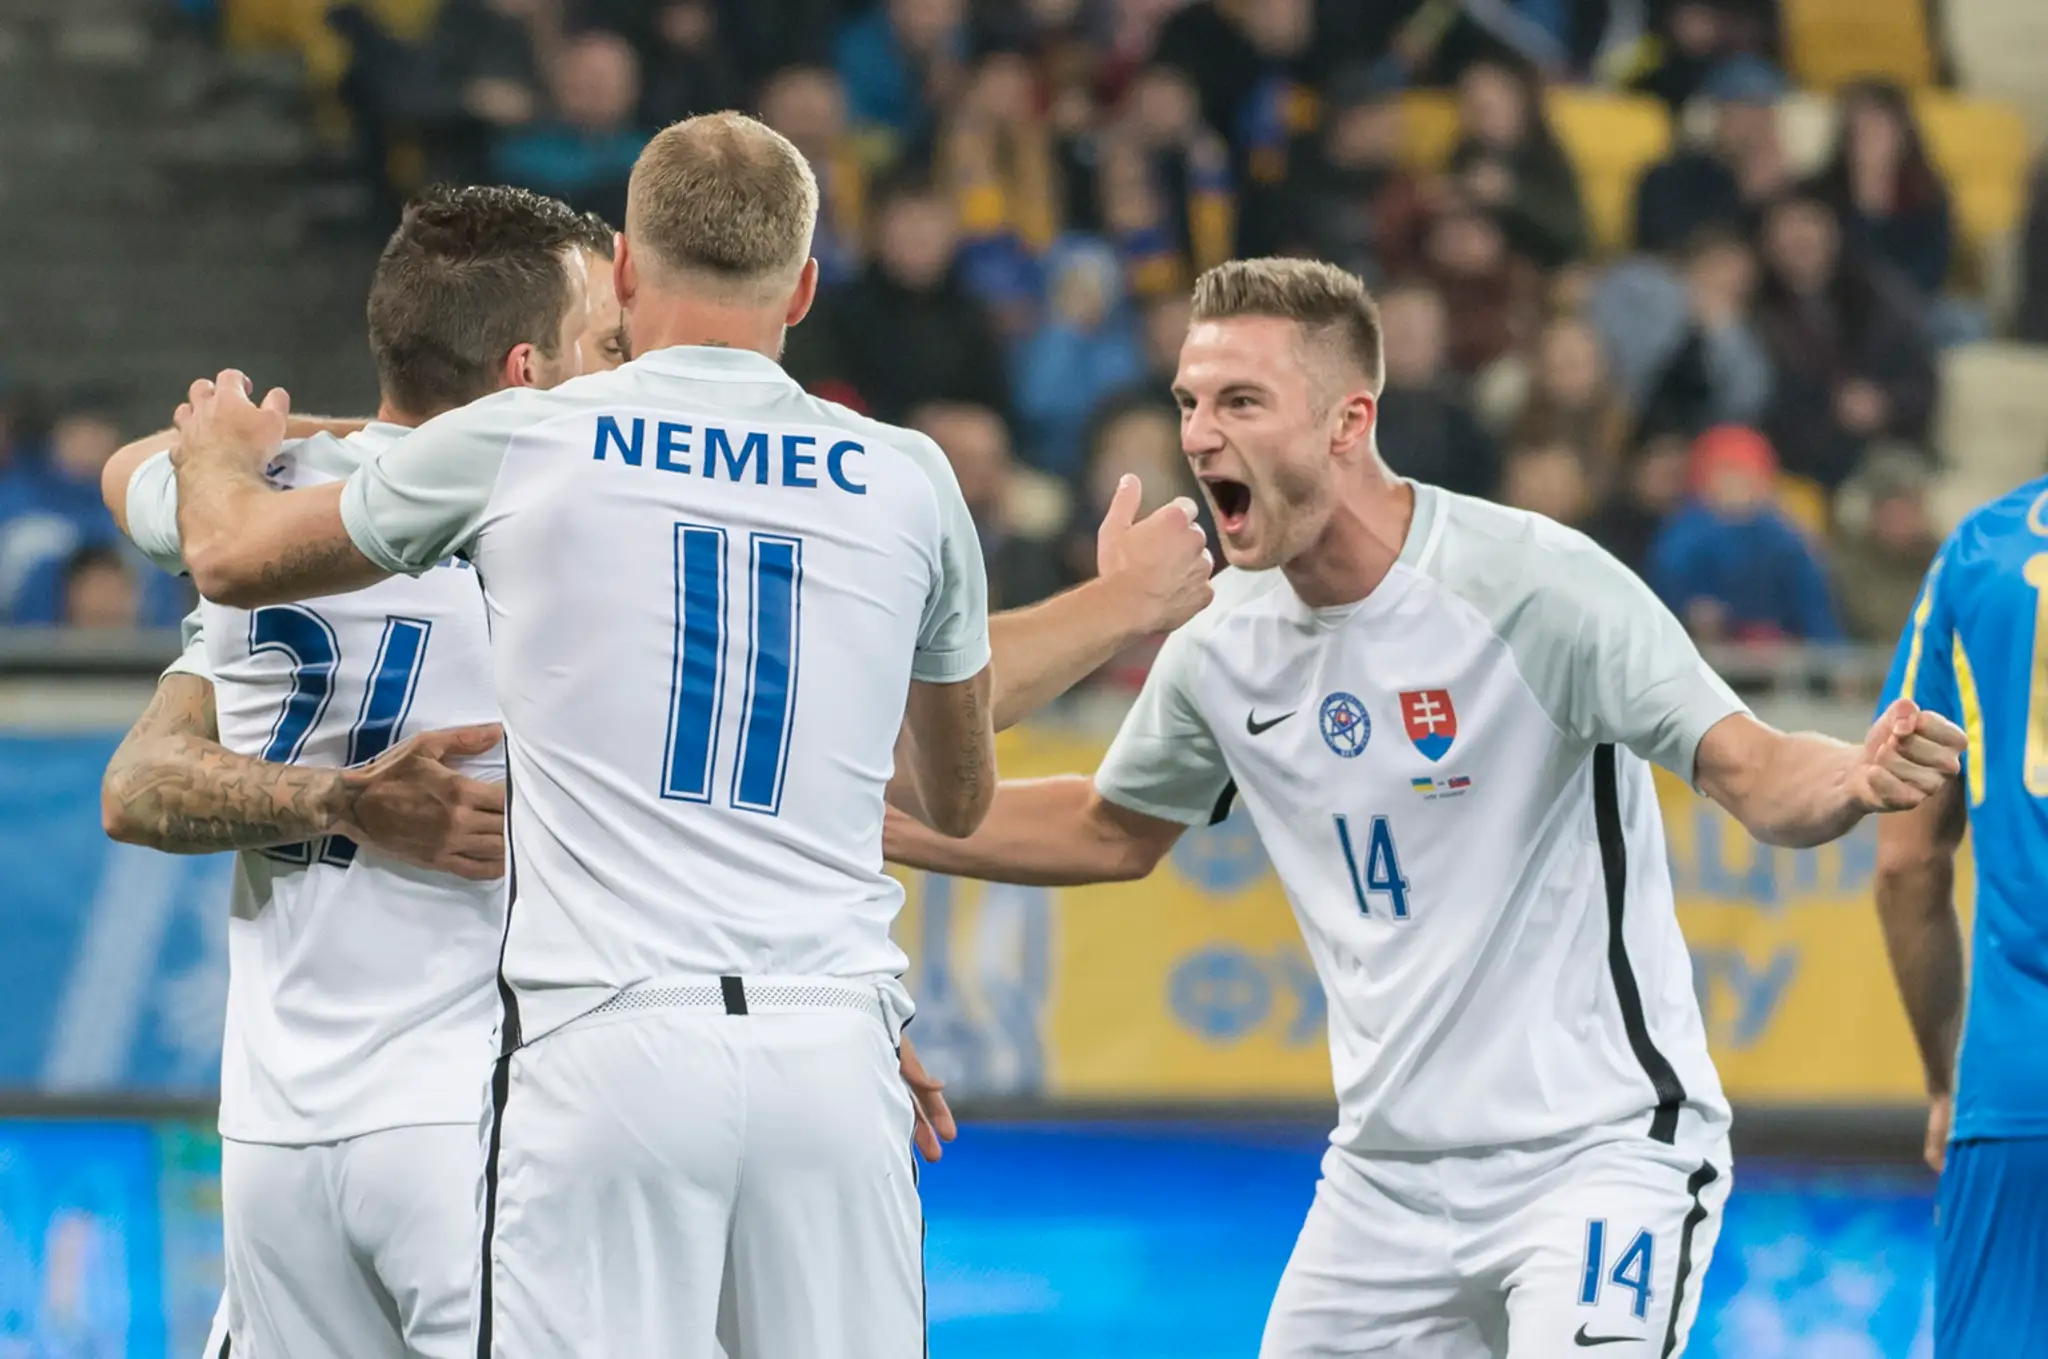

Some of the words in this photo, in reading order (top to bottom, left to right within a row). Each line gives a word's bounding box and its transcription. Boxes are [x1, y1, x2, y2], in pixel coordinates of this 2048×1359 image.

[593, 415, 867, 495] NEMEC
[660, 522, 802, 816] 11
[1332, 813, 1411, 920] 14
[1577, 1217, 1656, 1323] 14
